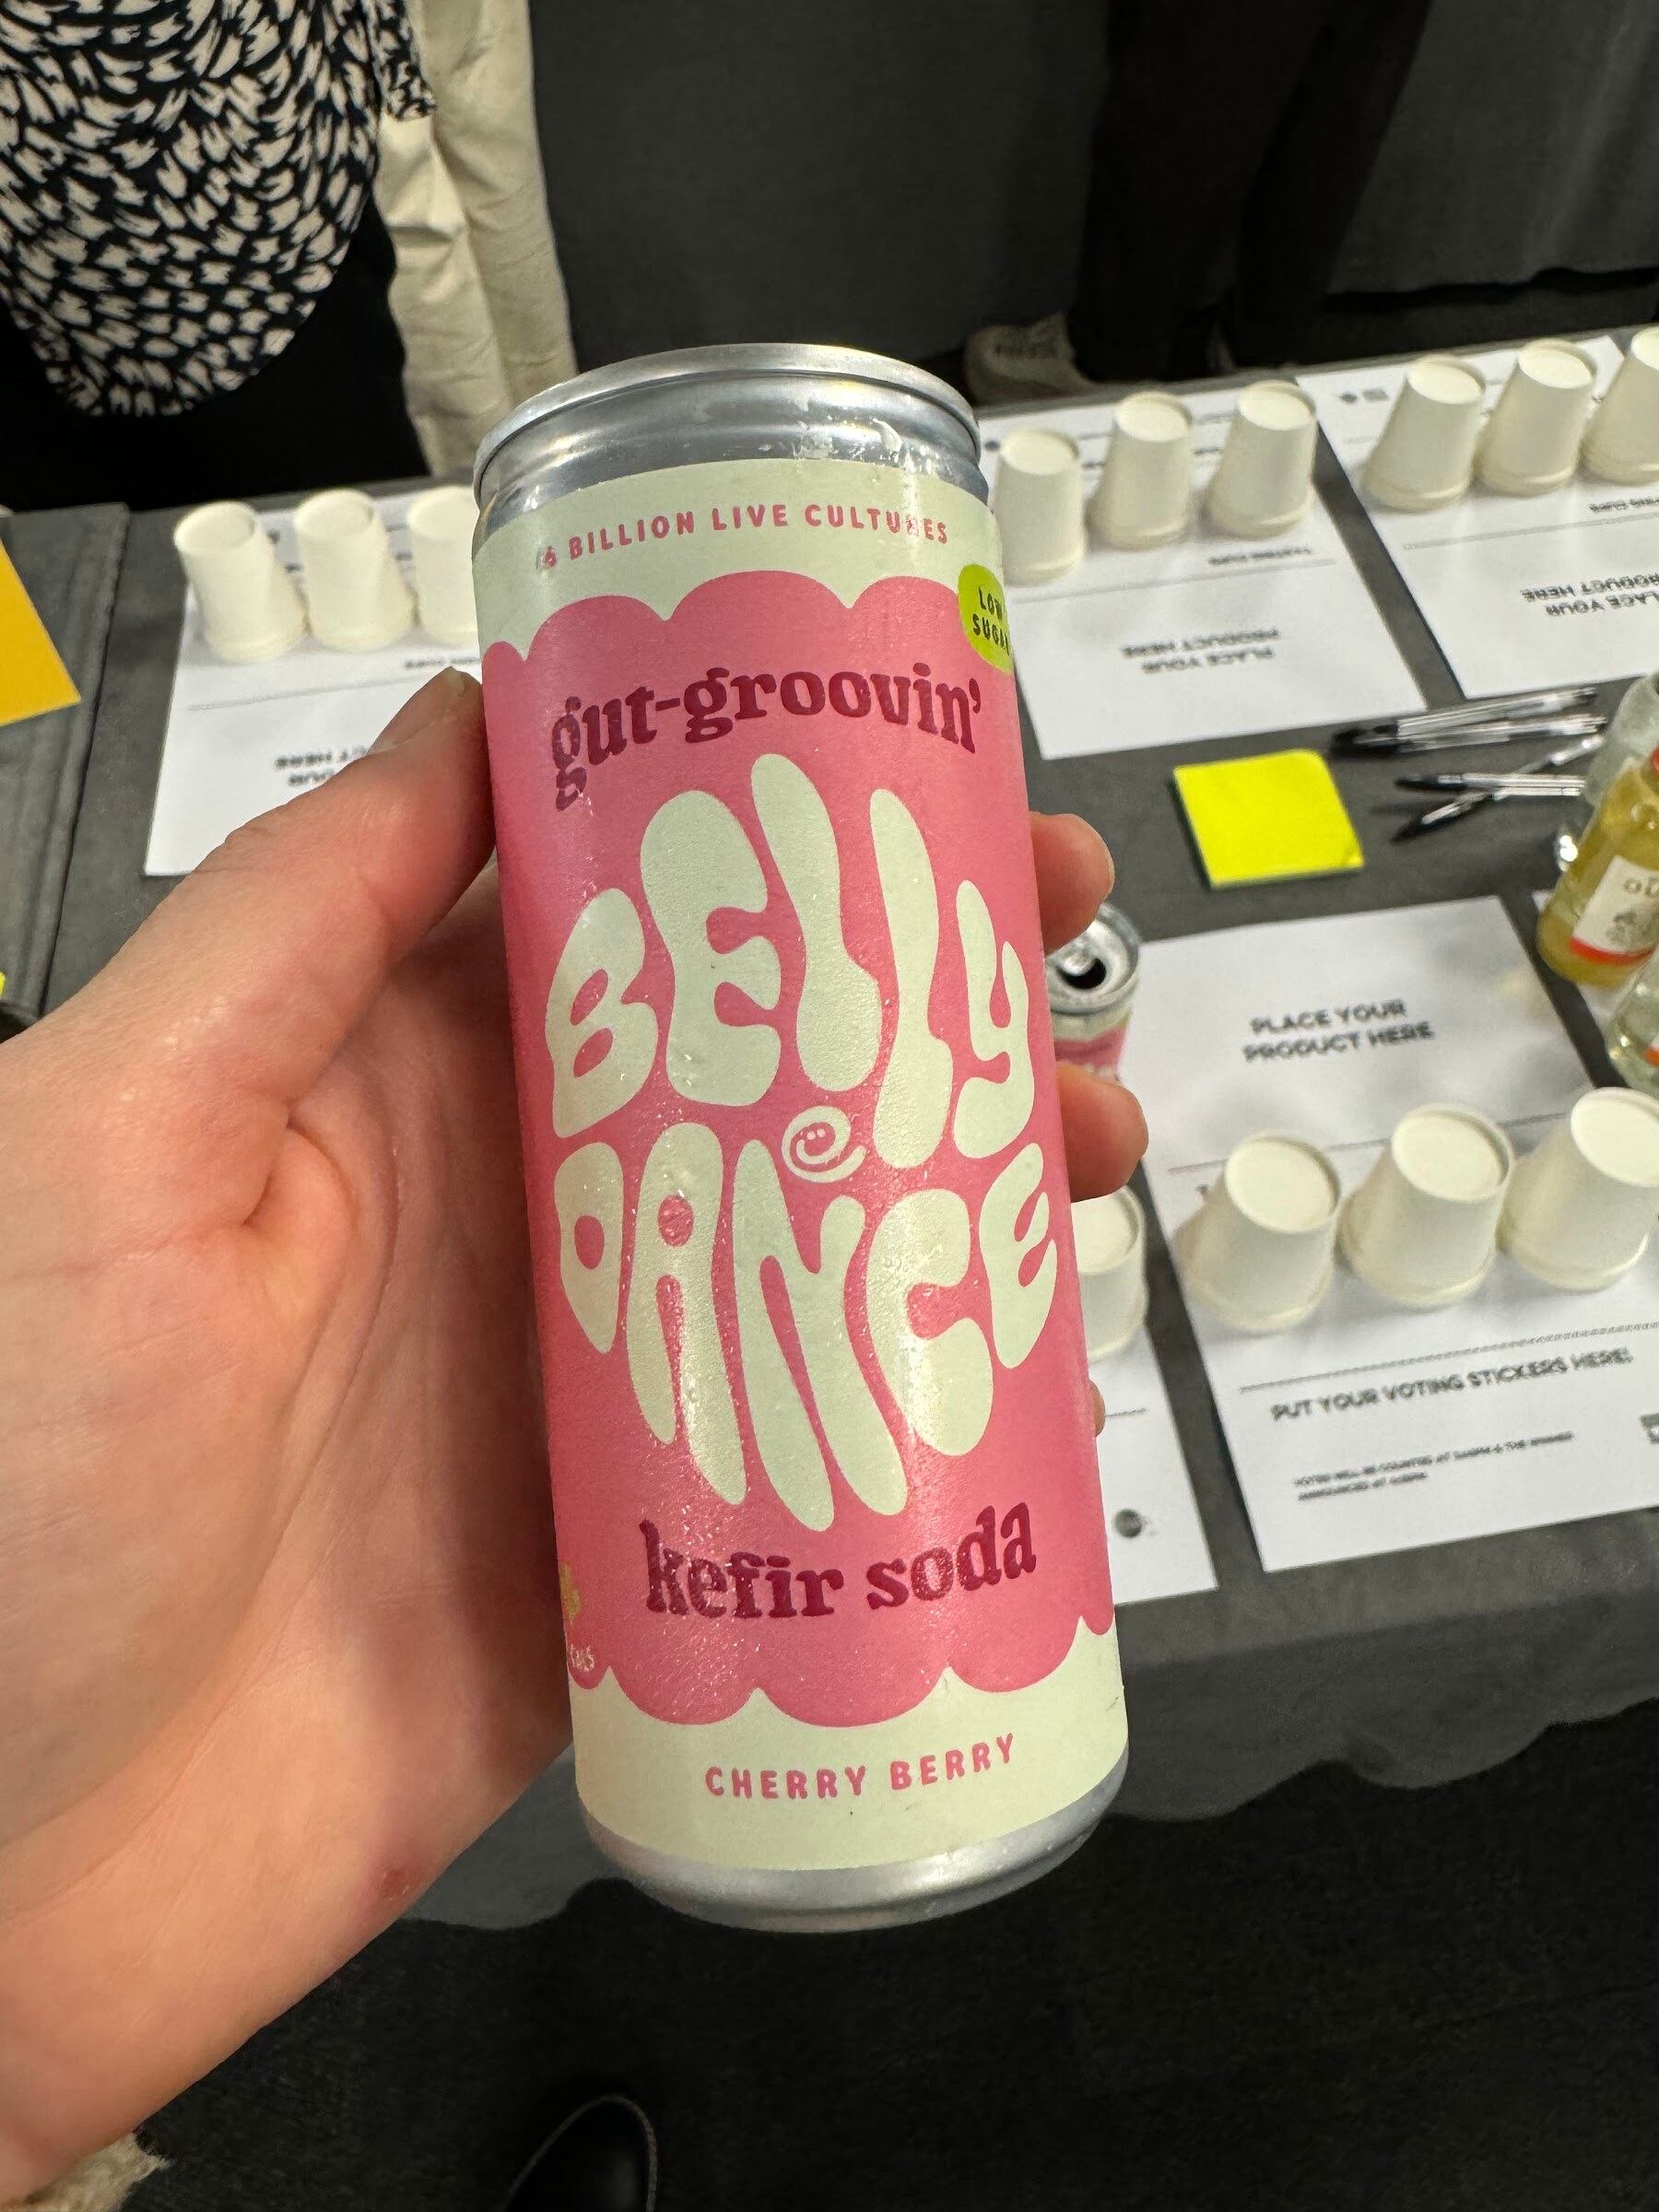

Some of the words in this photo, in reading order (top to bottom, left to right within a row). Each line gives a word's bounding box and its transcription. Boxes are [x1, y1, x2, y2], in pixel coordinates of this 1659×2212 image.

[568, 511, 695, 560] BILLION
[712, 503, 788, 531] LIVE
[804, 503, 948, 545] CULTURES
[1520, 584, 1576, 604] HERE
[1546, 599, 1606, 618] YOUR
[1581, 573, 1659, 596] RODUCT
[1606, 591, 1659, 610] LACE
[551, 662, 982, 811] gut-groovin'
[545, 753, 1034, 1169] BELLY
[1241, 1031, 1361, 1063] PRODUCT
[1368, 1020, 1436, 1046] HERE
[1250, 1006, 1331, 1035] PLACE
[1336, 998, 1407, 1024] YOUR
[554, 1123, 1057, 1532] DANCE
[1271, 1398, 1313, 1421] PUT
[1320, 1388, 1380, 1415] YOUR
[1382, 1375, 1465, 1403] VOTING
[1466, 1356, 1569, 1389] STICKERS
[640, 1520, 844, 1618] kefir
[865, 1502, 1038, 1610] soda
[704, 1765, 866, 1799] CHERRY
[890, 1734, 1015, 1792] BERRY
